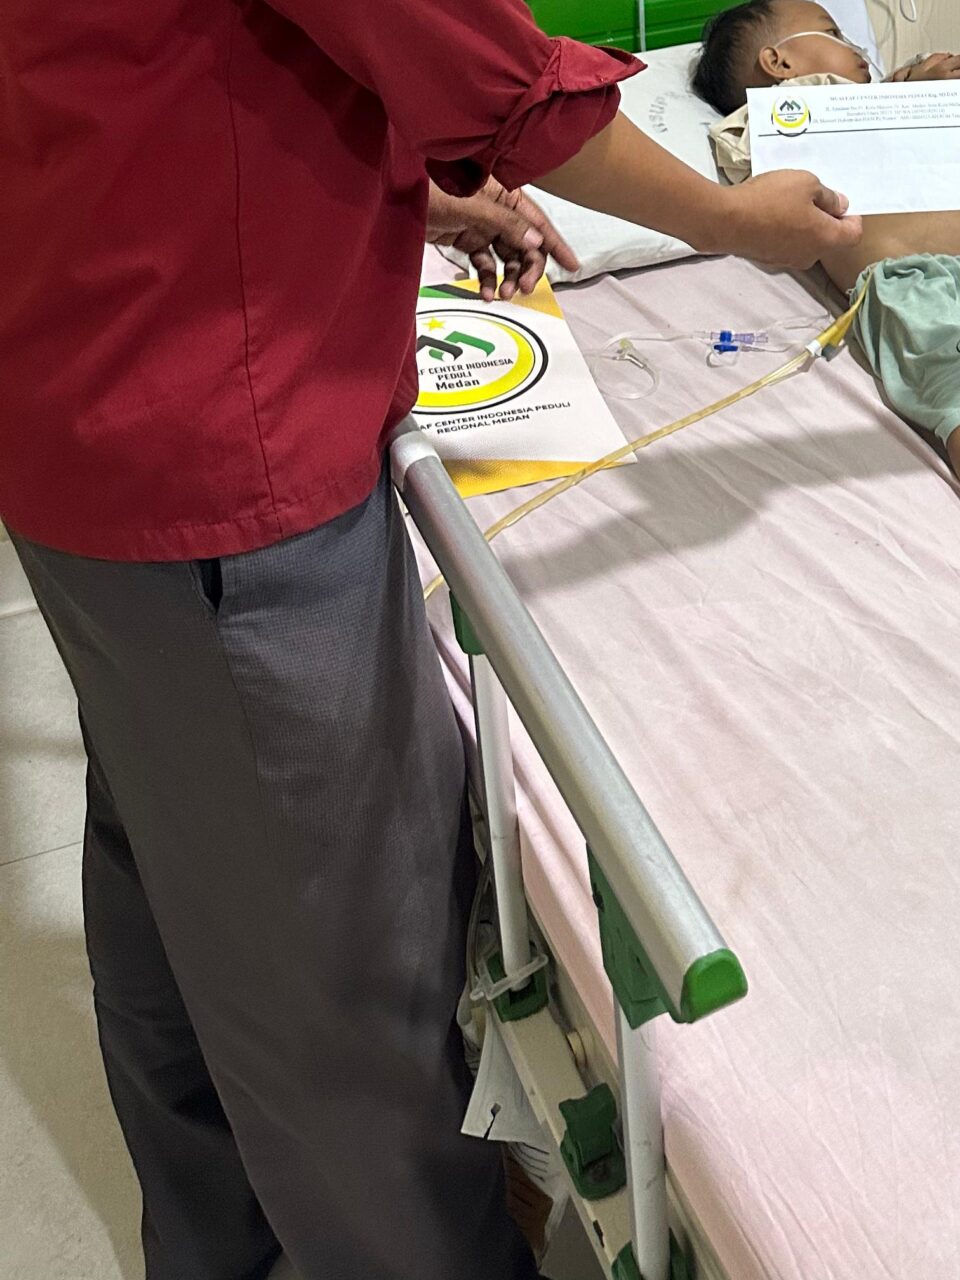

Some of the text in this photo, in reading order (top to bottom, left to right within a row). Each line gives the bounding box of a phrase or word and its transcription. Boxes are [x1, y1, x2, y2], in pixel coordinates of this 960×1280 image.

[428, 364, 463, 375] CENTER
[466, 358, 514, 370] INDONESIA
[437, 371, 472, 381] PEDULI
[436, 379, 480, 391] Medan
[434, 416, 475, 428] CENTER
[477, 407, 534, 420] INDONESIA
[535, 402, 571, 412] PEDULI
[437, 414, 530, 434] REGIONAL MEDAN
